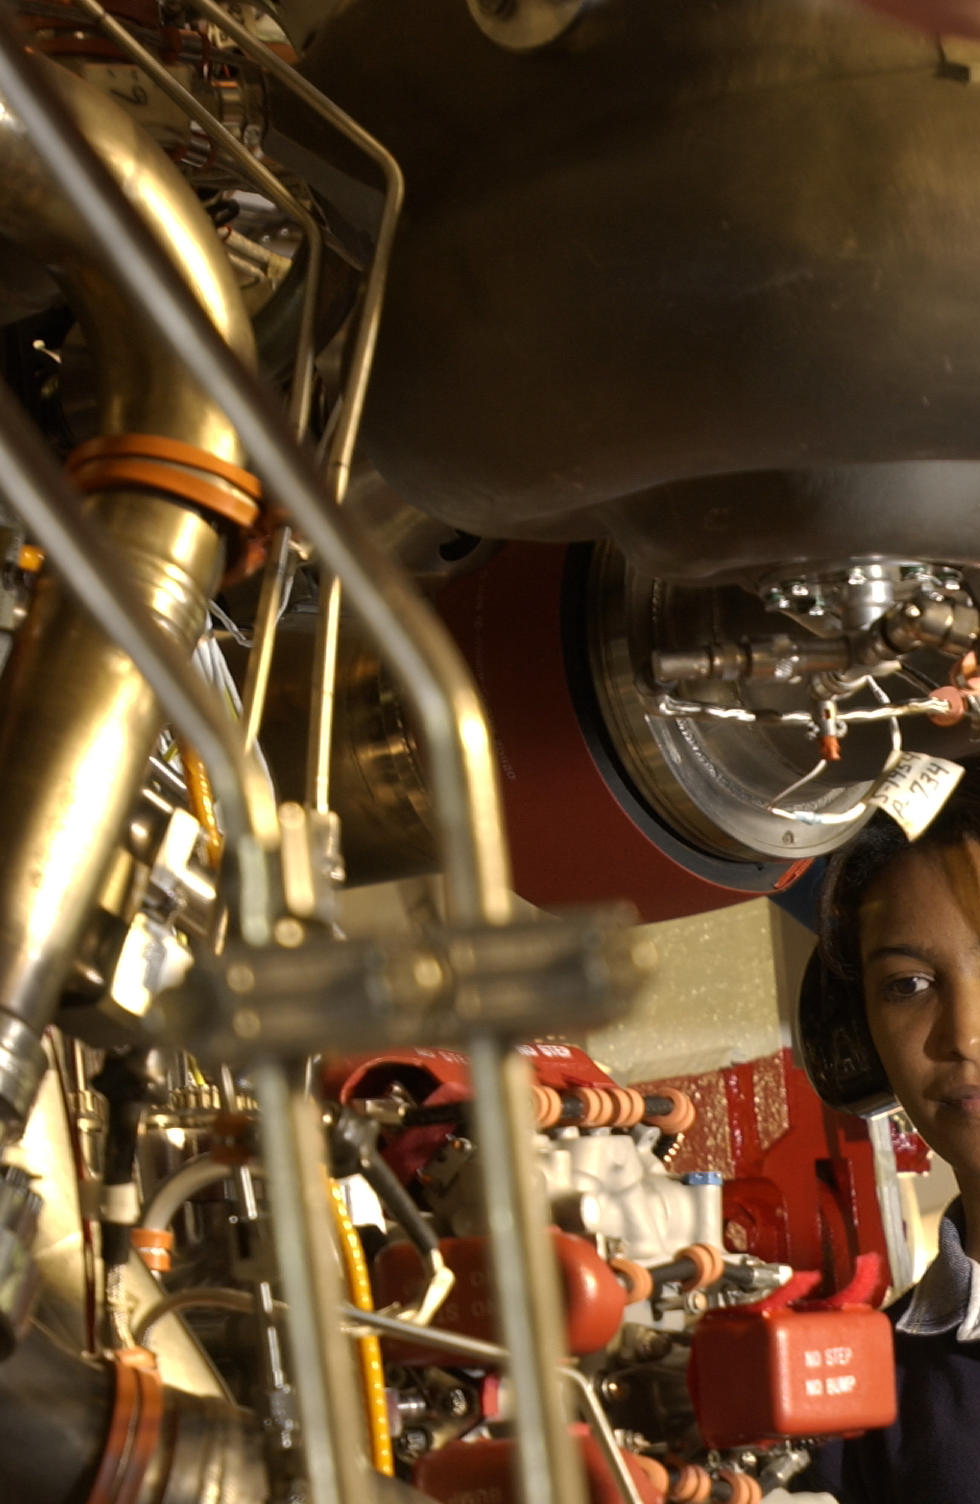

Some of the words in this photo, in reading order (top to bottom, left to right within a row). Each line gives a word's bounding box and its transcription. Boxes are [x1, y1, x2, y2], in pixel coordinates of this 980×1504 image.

[804, 1350, 821, 1368] NO
[824, 1346, 853, 1367] STEP
[805, 1378, 823, 1396] NO
[825, 1375, 857, 1396] BUMP
